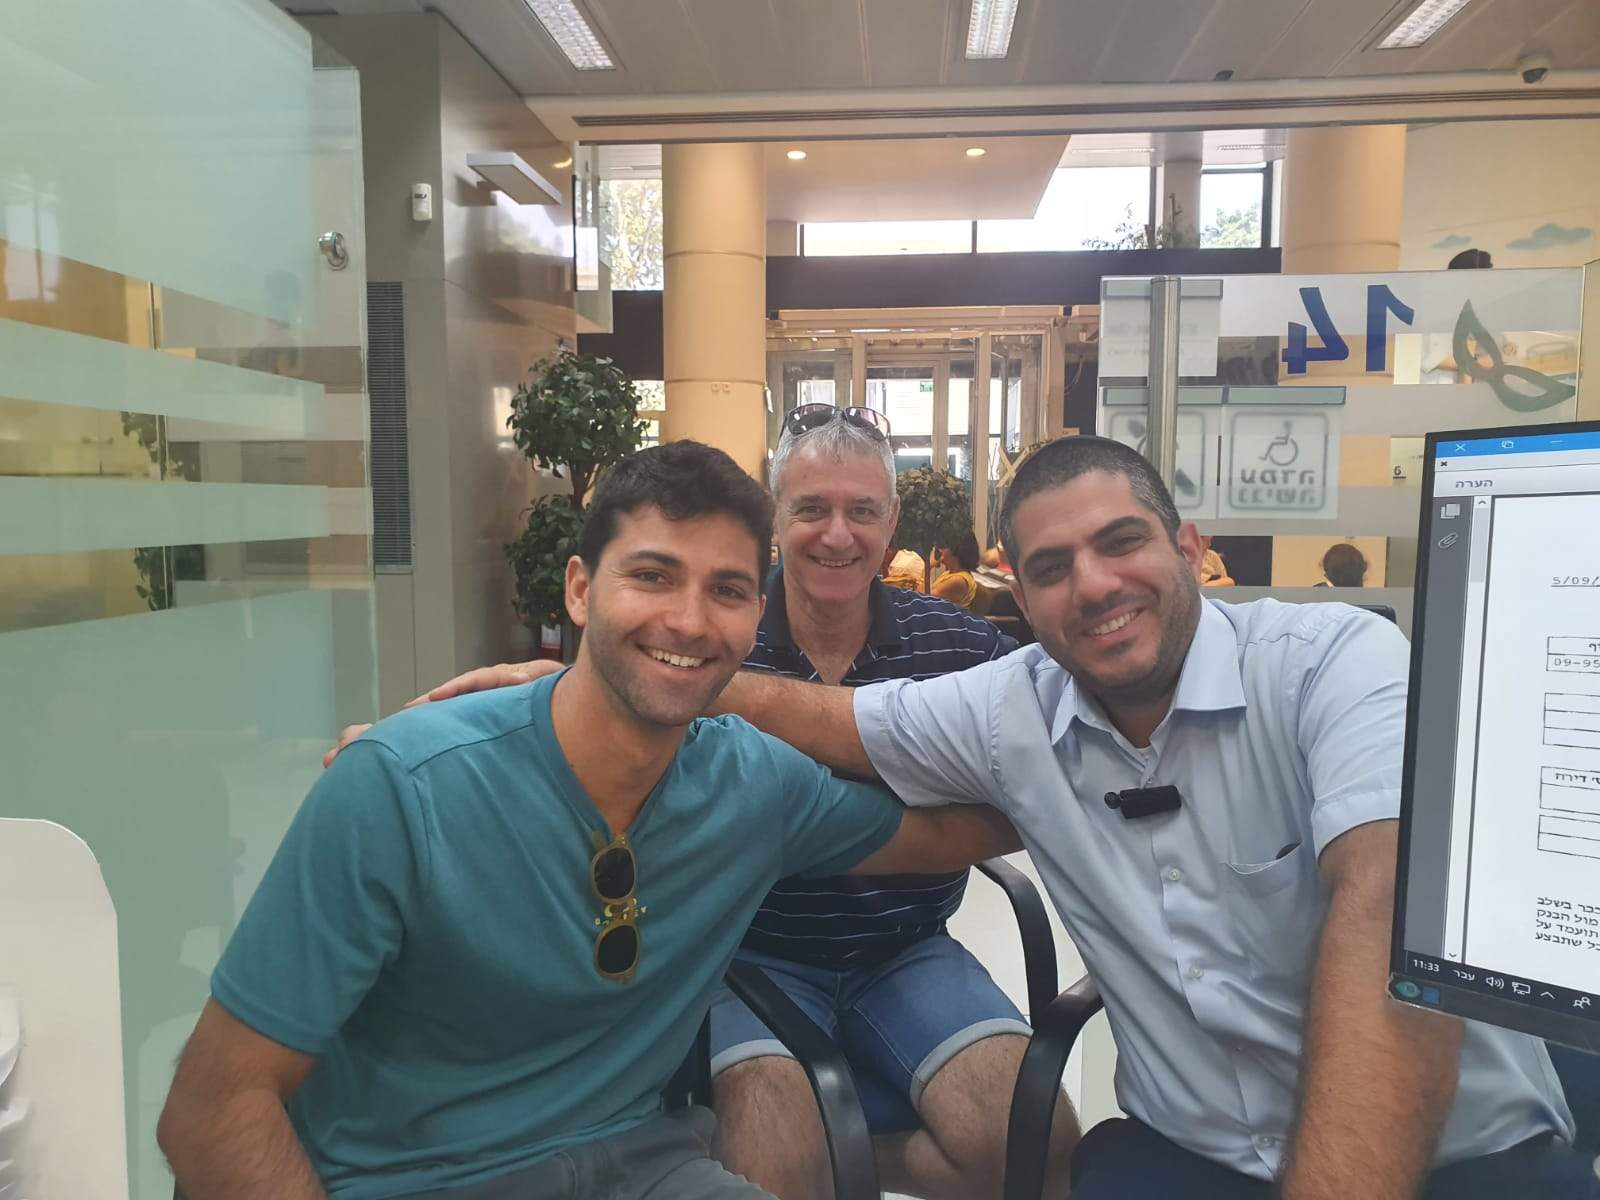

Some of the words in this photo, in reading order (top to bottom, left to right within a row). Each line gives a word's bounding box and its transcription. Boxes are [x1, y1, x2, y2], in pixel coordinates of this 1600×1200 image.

[1455, 479, 1494, 488] הערה
[1555, 773, 1587, 783] דירה
[1537, 897, 1572, 910] בשלב
[1537, 909, 1570, 921] הבנק
[1574, 914, 1599, 926] מול
[1536, 919, 1552, 930] על
[1535, 932, 1582, 947] שתבצע
[1413, 959, 1440, 972] 11:33
[1453, 969, 1475, 981] עבר
